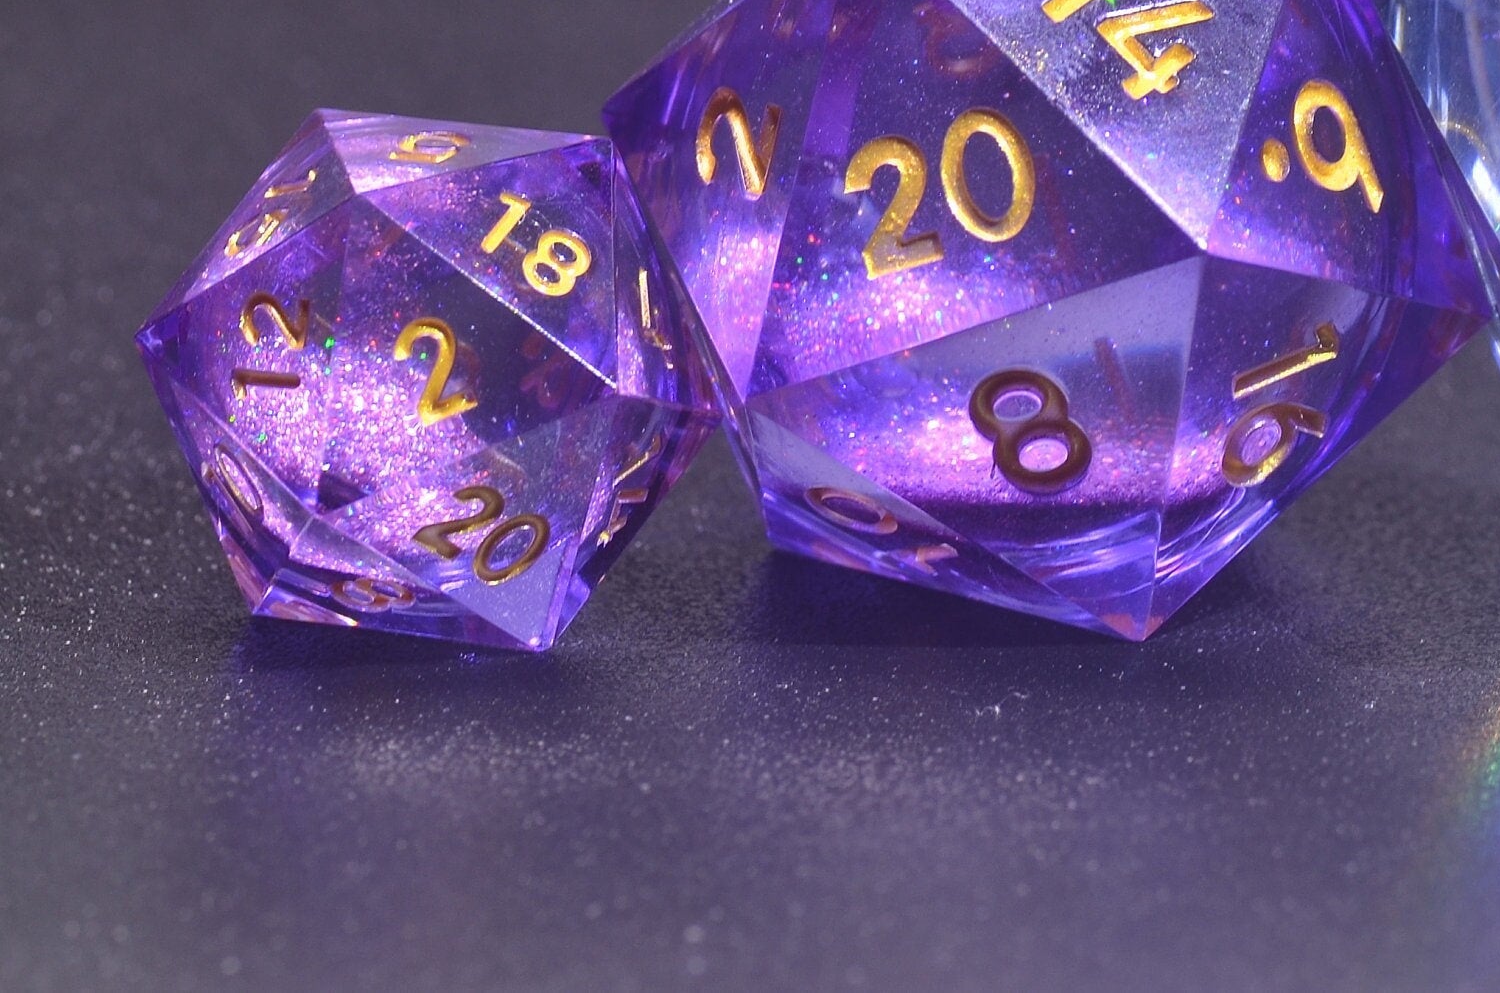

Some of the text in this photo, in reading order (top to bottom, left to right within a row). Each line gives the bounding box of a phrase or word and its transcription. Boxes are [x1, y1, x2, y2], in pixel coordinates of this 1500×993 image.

[696, 87, 782, 200] 2
[844, 107, 1036, 280] 20
[482, 191, 592, 297] 18
[232, 291, 309, 399] 12
[394, 317, 478, 426] 2
[968, 366, 1092, 494] 8
[1222, 321, 1339, 488] 16
[413, 485, 551, 586] 20
